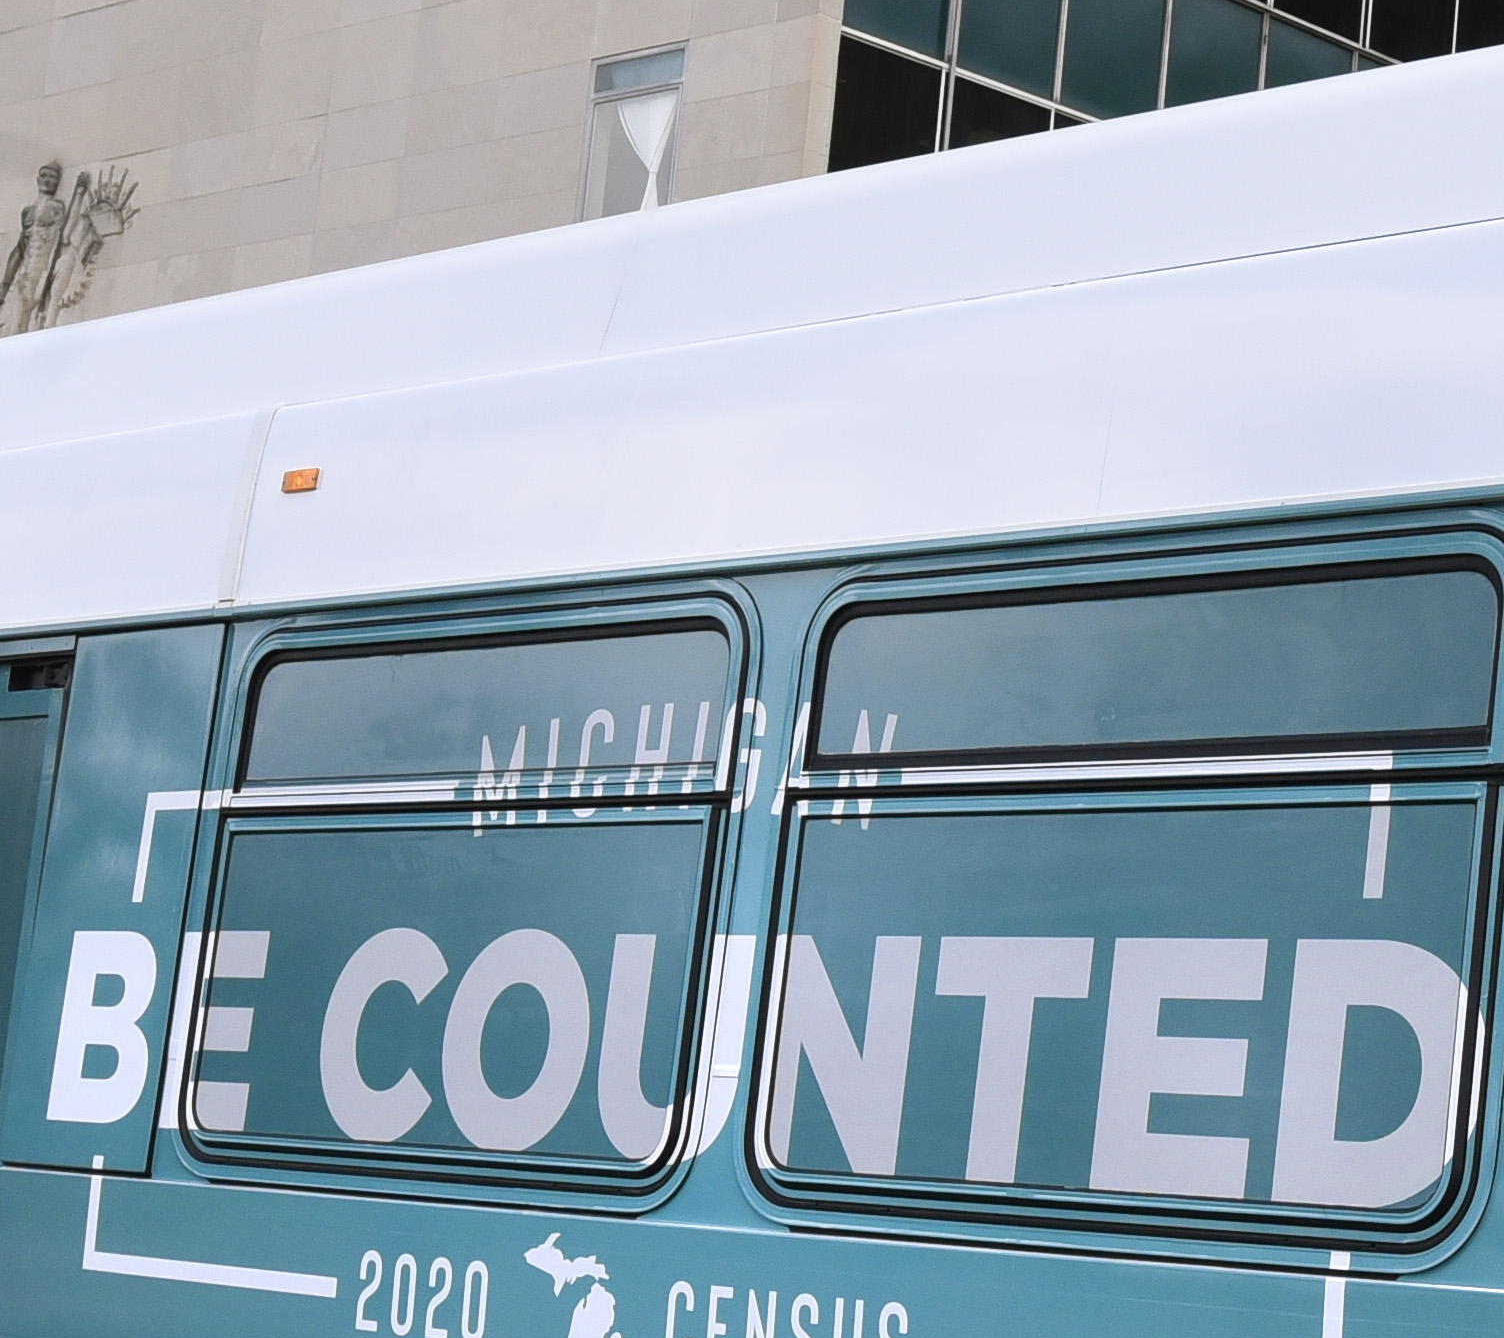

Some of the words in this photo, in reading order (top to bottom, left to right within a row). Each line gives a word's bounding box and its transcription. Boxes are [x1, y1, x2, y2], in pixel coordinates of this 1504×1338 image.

[472, 697, 898, 838] MICHIGAN
[46, 930, 271, 1131] BE
[319, 927, 1486, 1209] COUNTED
